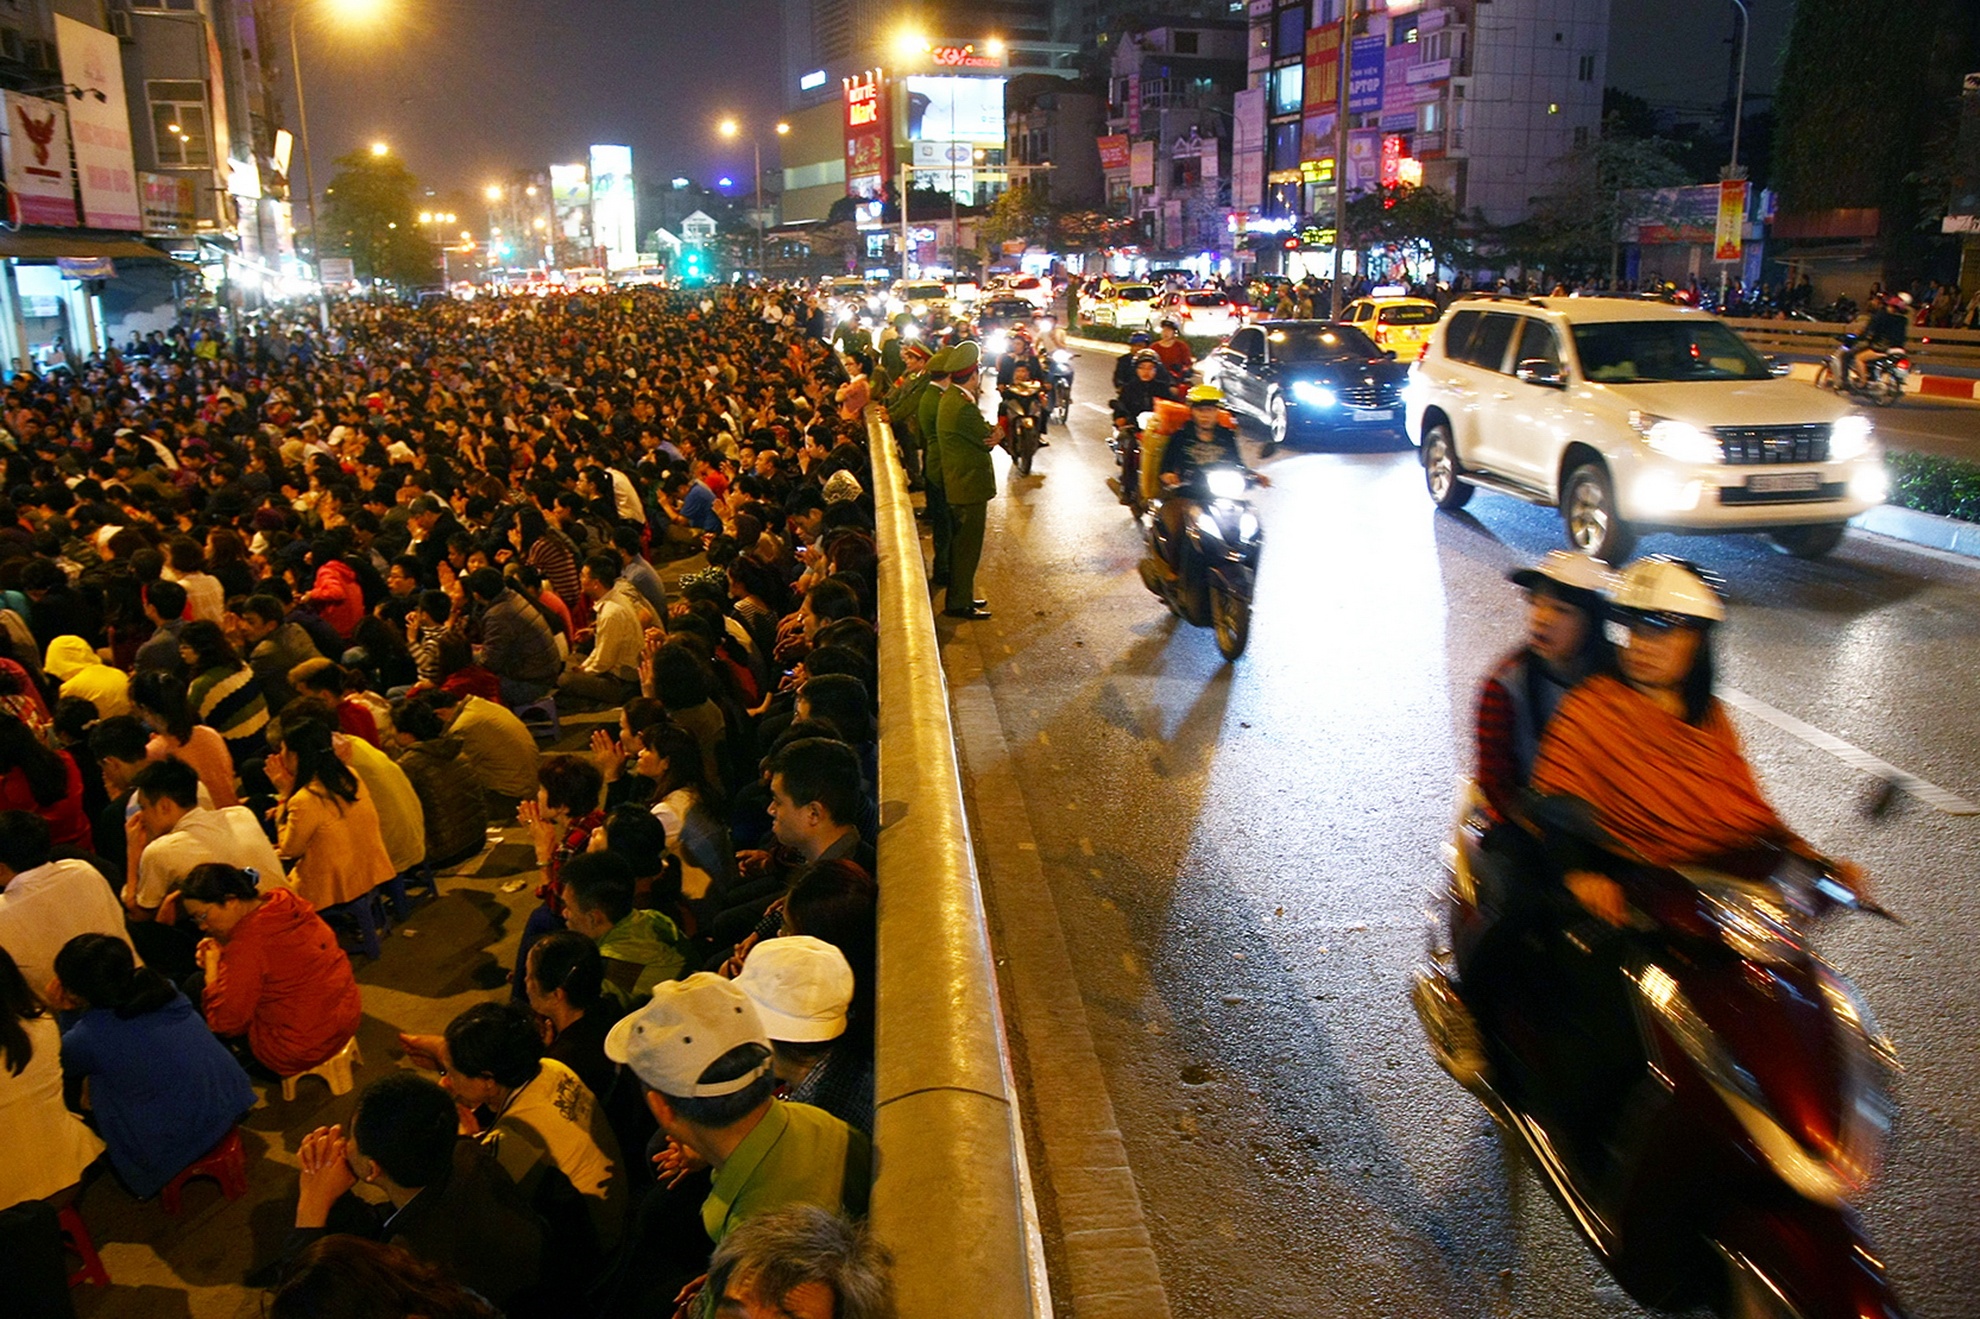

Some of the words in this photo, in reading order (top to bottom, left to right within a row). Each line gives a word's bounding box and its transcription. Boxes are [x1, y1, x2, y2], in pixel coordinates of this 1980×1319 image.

[933, 46, 968, 66] CGV
[850, 83, 877, 103] LOTTE
[1349, 77, 1380, 95] APTOP
[850, 101, 877, 126] Mart
